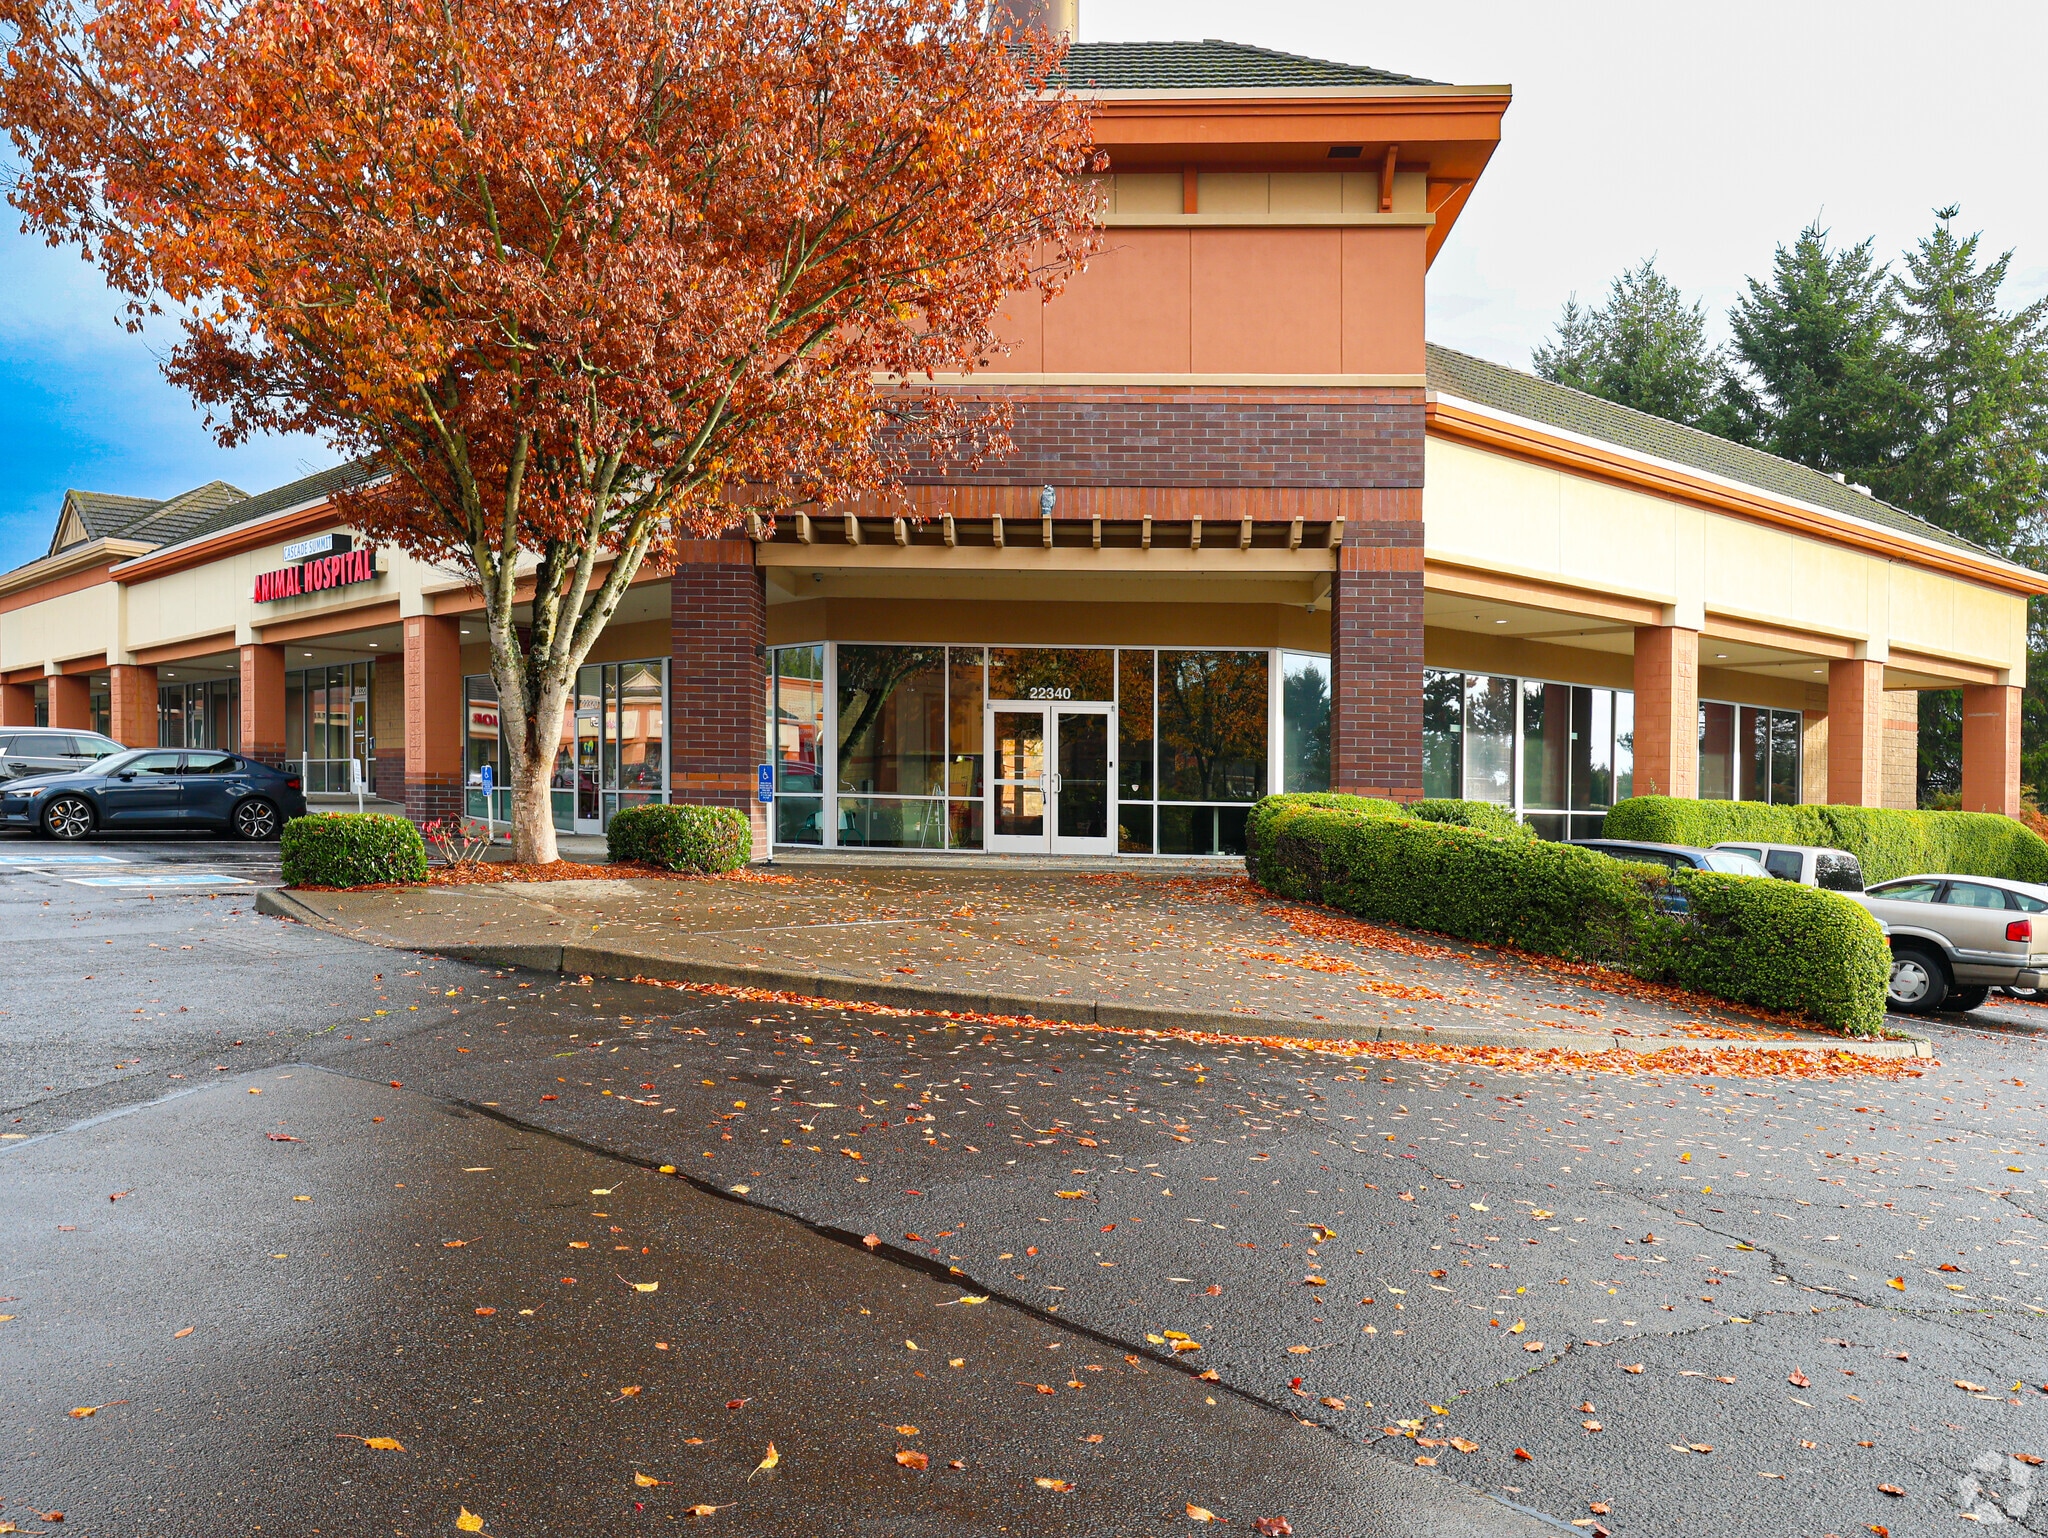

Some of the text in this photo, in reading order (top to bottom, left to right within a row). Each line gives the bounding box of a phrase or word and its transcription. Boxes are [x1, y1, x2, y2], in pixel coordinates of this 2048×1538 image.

[284, 535, 331, 560] CASCADE SUMMIT
[254, 549, 372, 603] ANIMAL HOSPITAL
[1030, 687, 1071, 700] 22340
